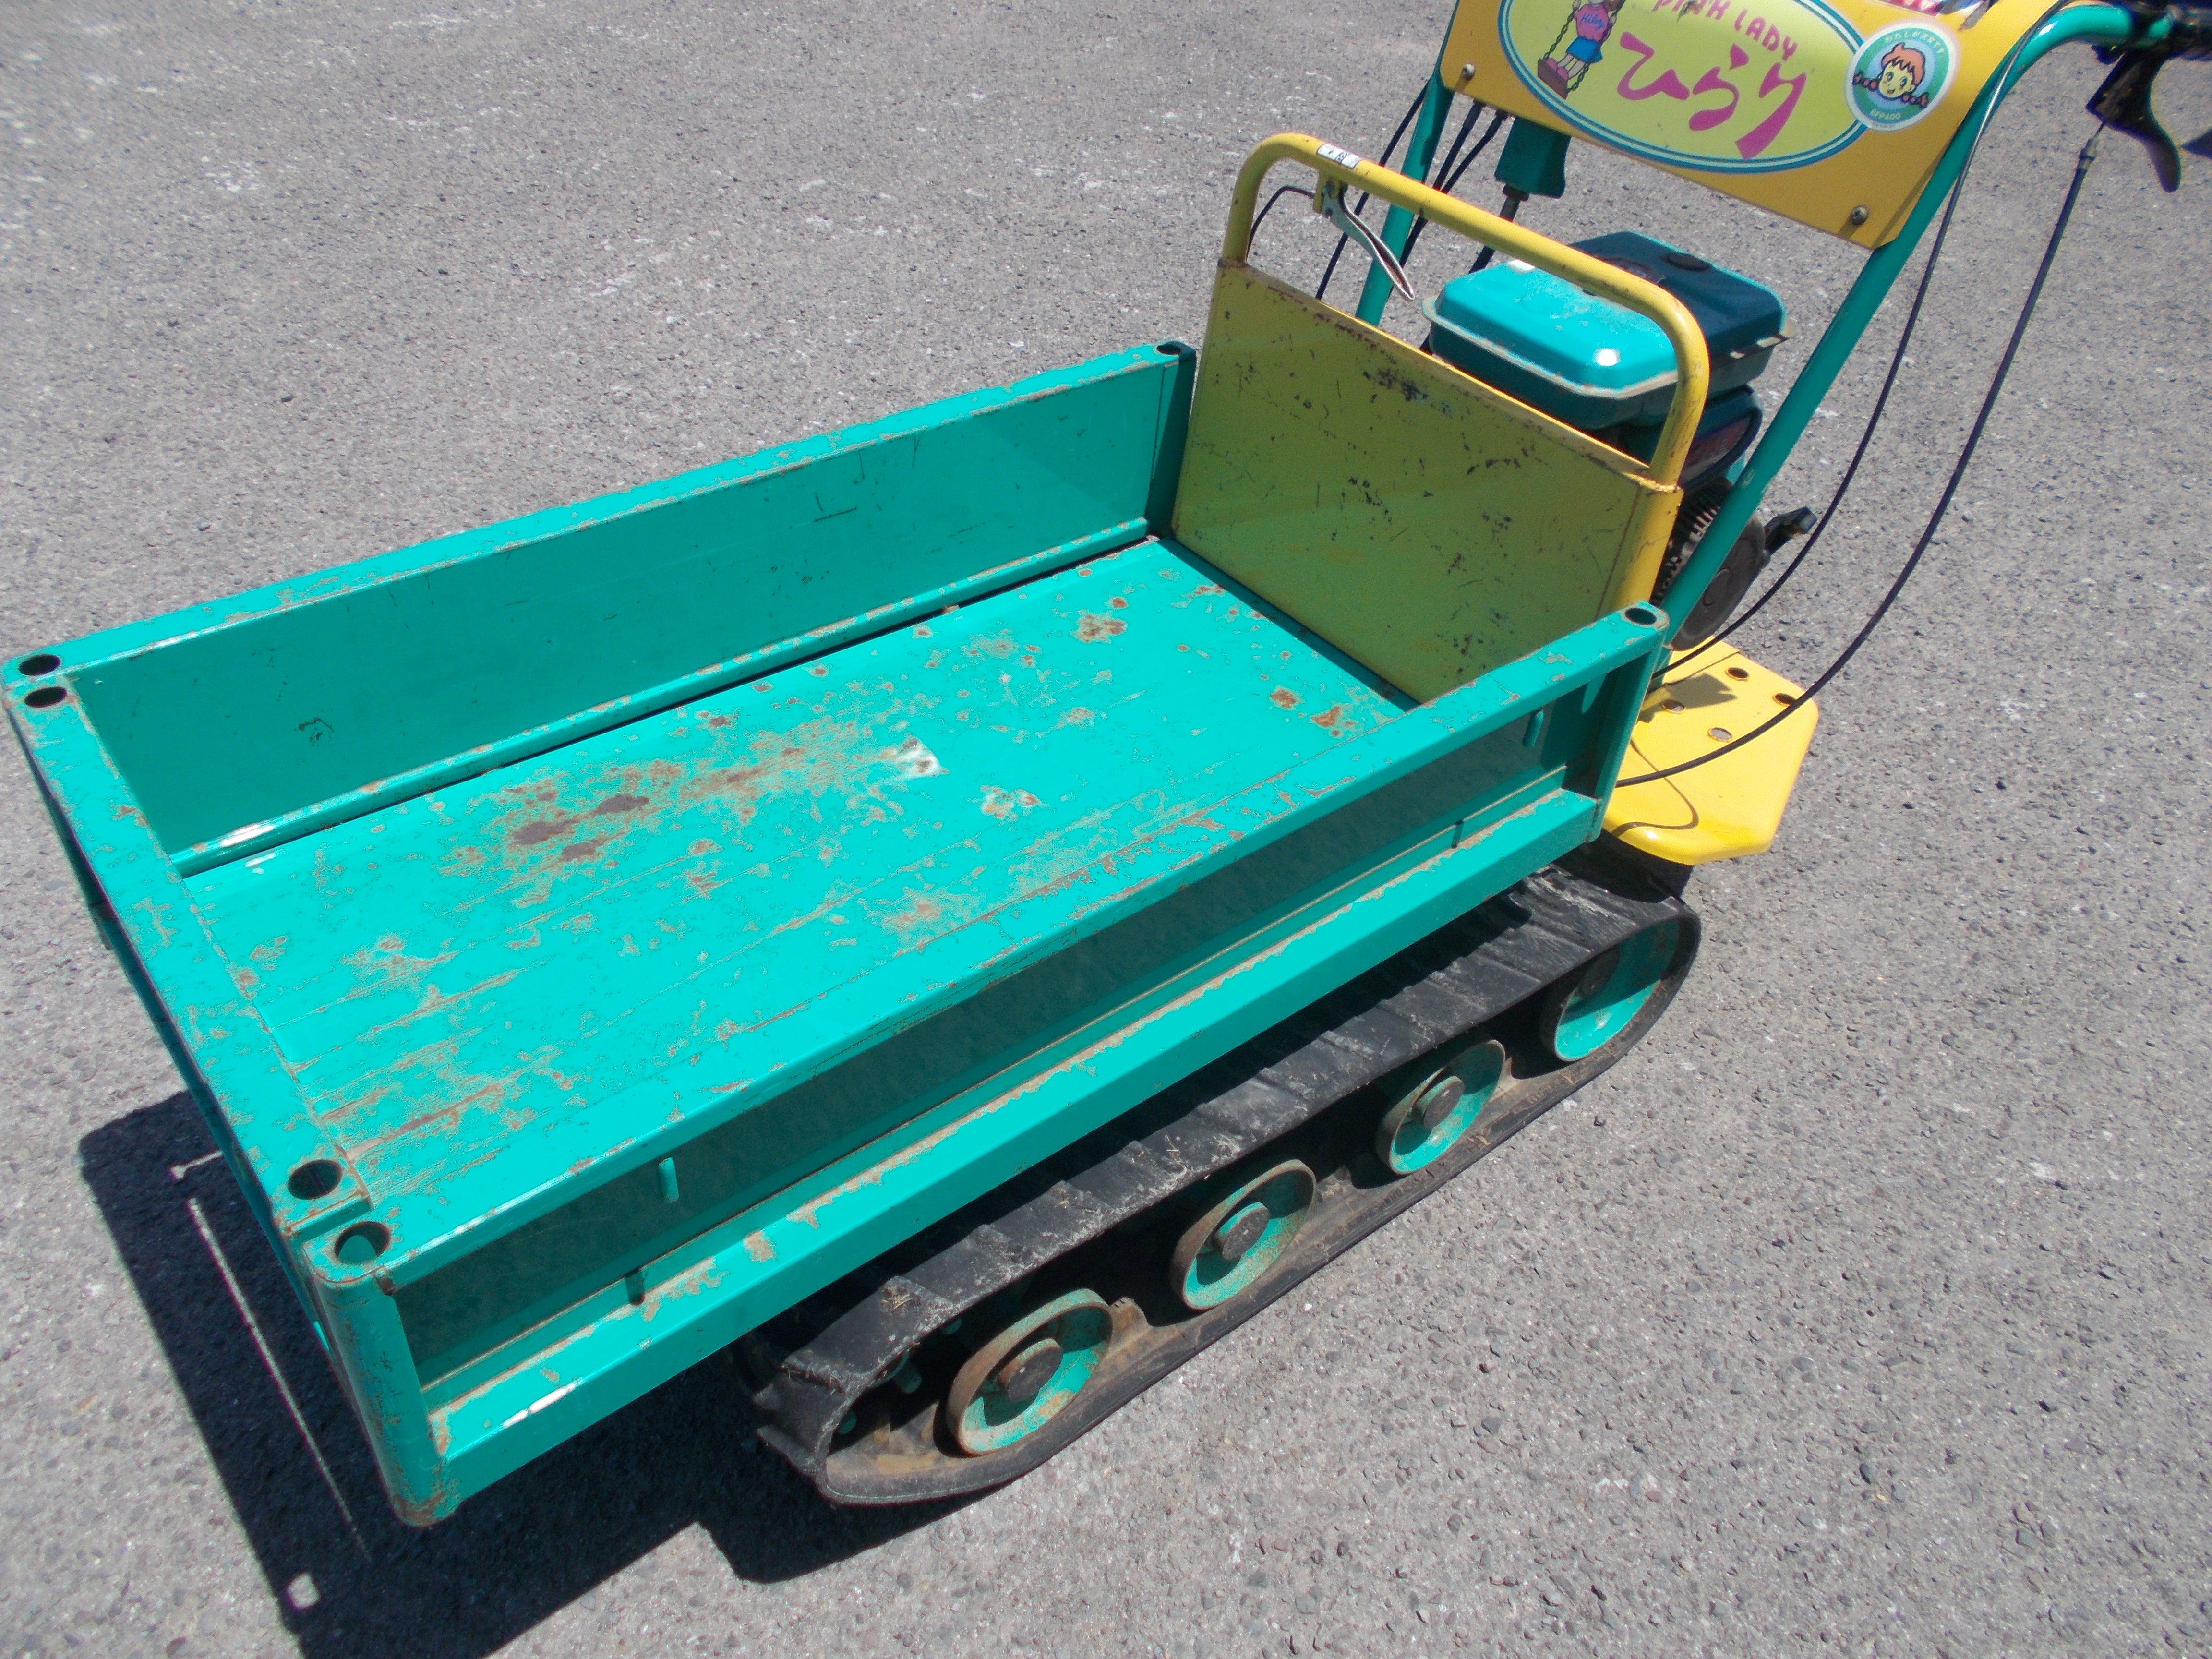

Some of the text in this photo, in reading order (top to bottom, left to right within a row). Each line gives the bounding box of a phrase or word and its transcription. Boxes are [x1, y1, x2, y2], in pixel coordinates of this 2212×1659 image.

[1734, 8, 1798, 61] LADY
[1617, 31, 1807, 160] ひらり
